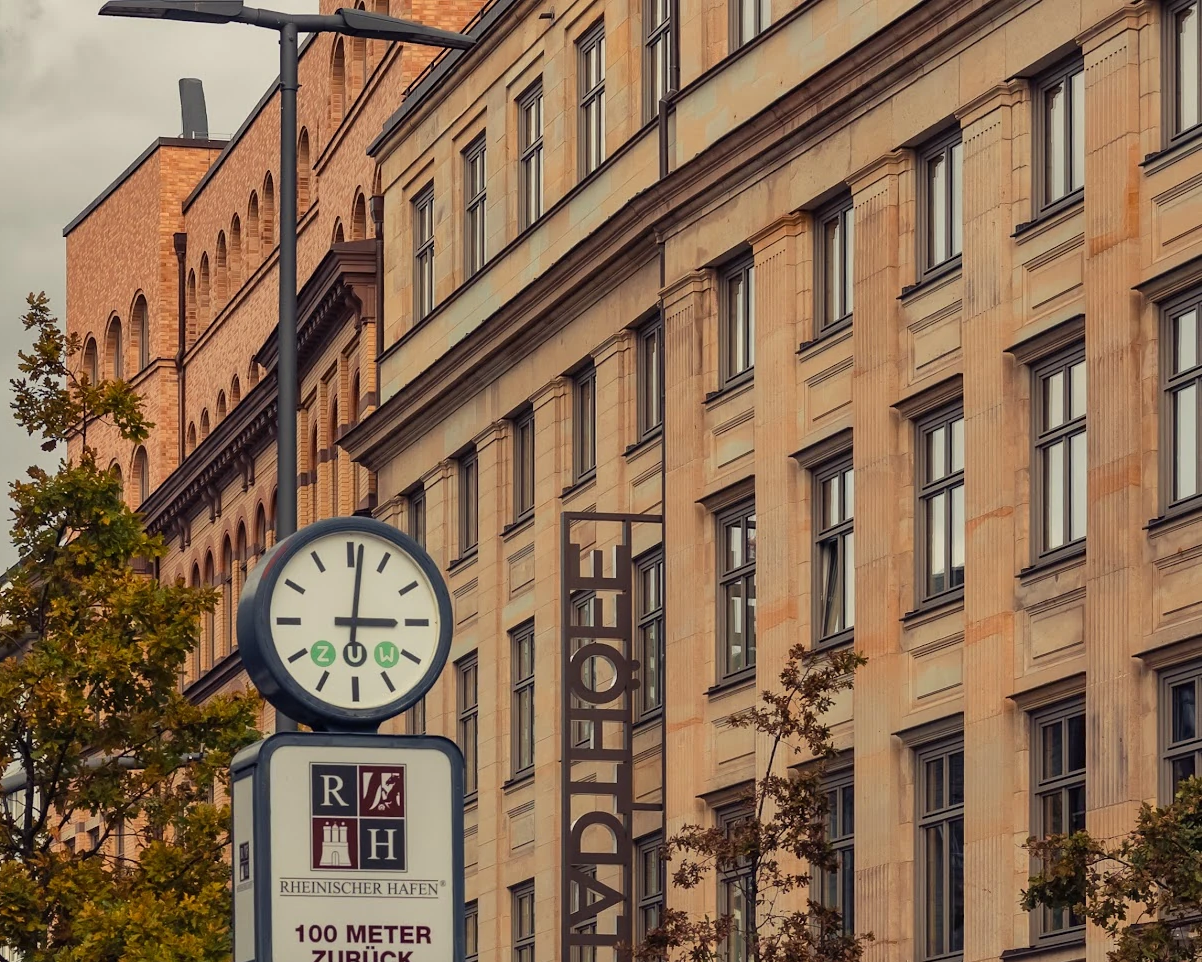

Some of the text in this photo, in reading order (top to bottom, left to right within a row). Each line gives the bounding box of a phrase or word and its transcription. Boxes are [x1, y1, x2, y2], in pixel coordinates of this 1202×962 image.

[316, 645, 394, 663] Z U W
[320, 774, 349, 807] R
[367, 828, 398, 860] H
[279, 881, 383, 895] RHEINISCHER
[295, 924, 432, 945] 100 METER
